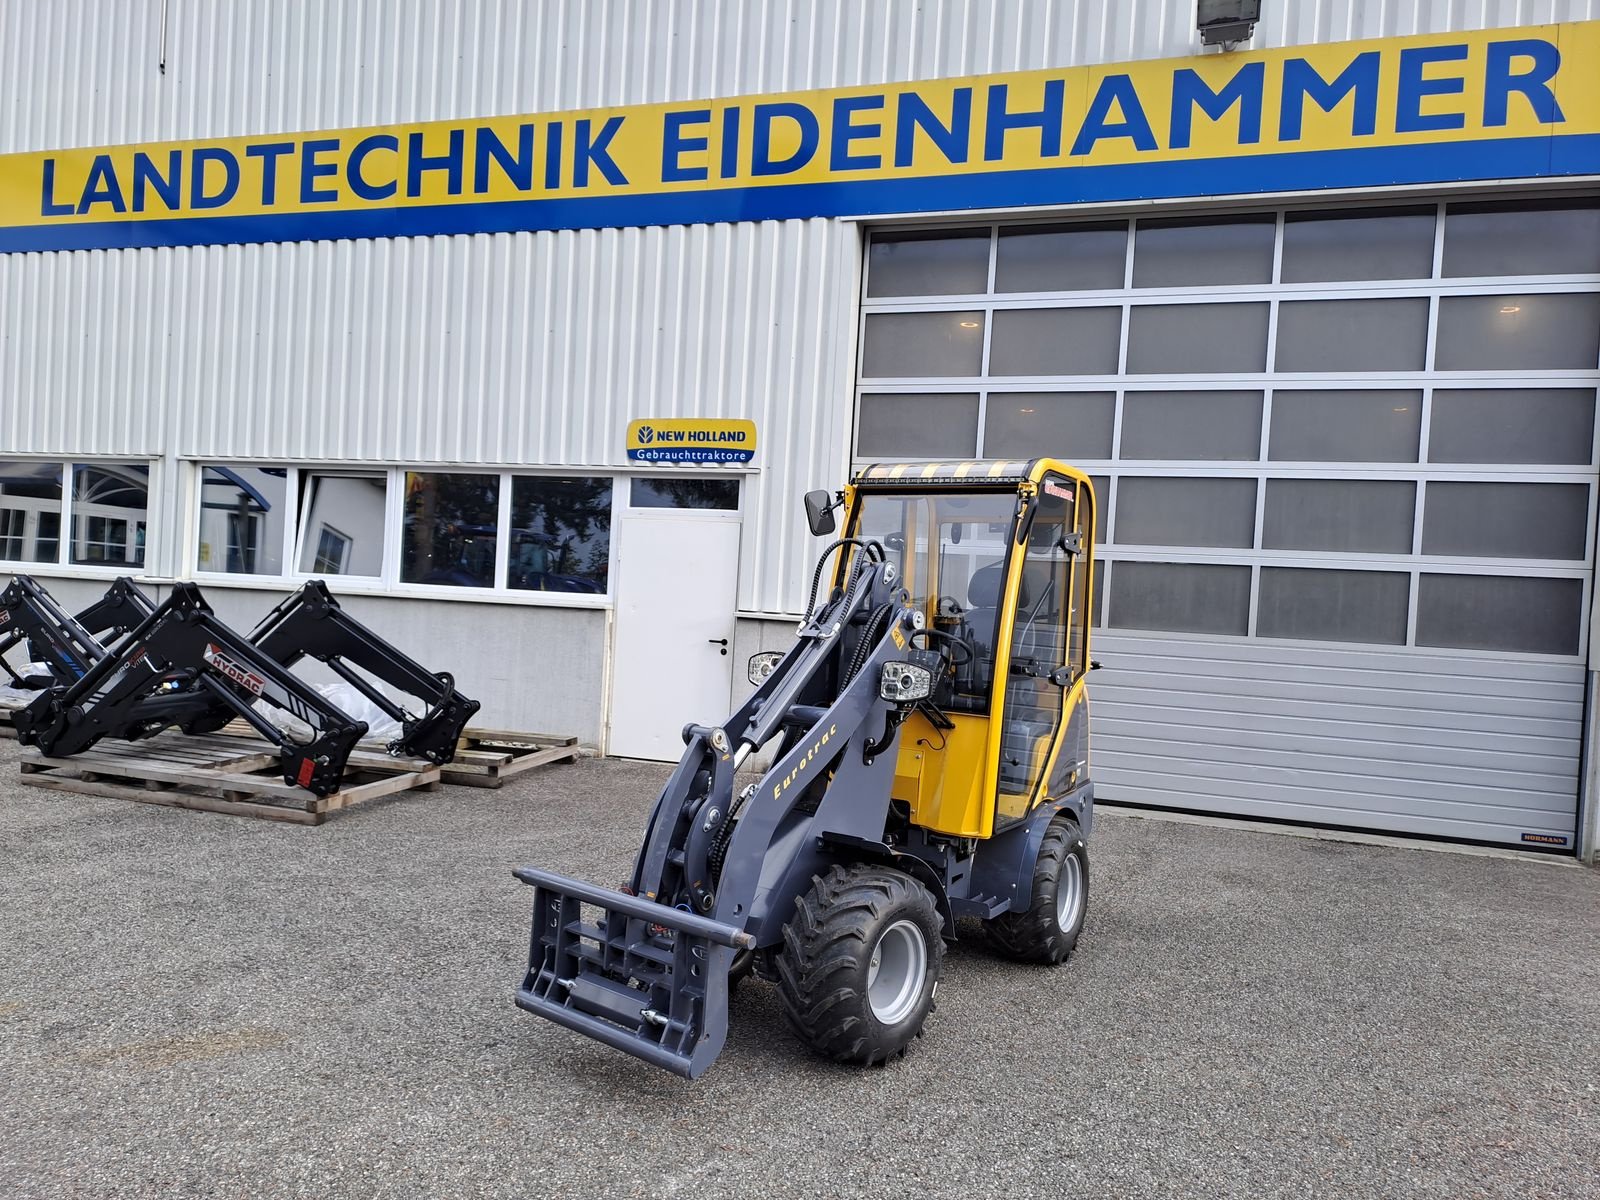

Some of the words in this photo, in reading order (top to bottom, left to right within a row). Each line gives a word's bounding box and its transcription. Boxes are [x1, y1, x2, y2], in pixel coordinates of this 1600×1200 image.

[42, 116, 629, 216] LANDTECHNIK
[661, 38, 1566, 184] EIDENHAMMER
[636, 449, 746, 460] Gebrauchttraktore
[656, 430, 685, 442] NEW
[687, 430, 746, 442] HOLLAND
[212, 656, 260, 693] HYDRAC
[773, 723, 837, 801] Eurotrac
